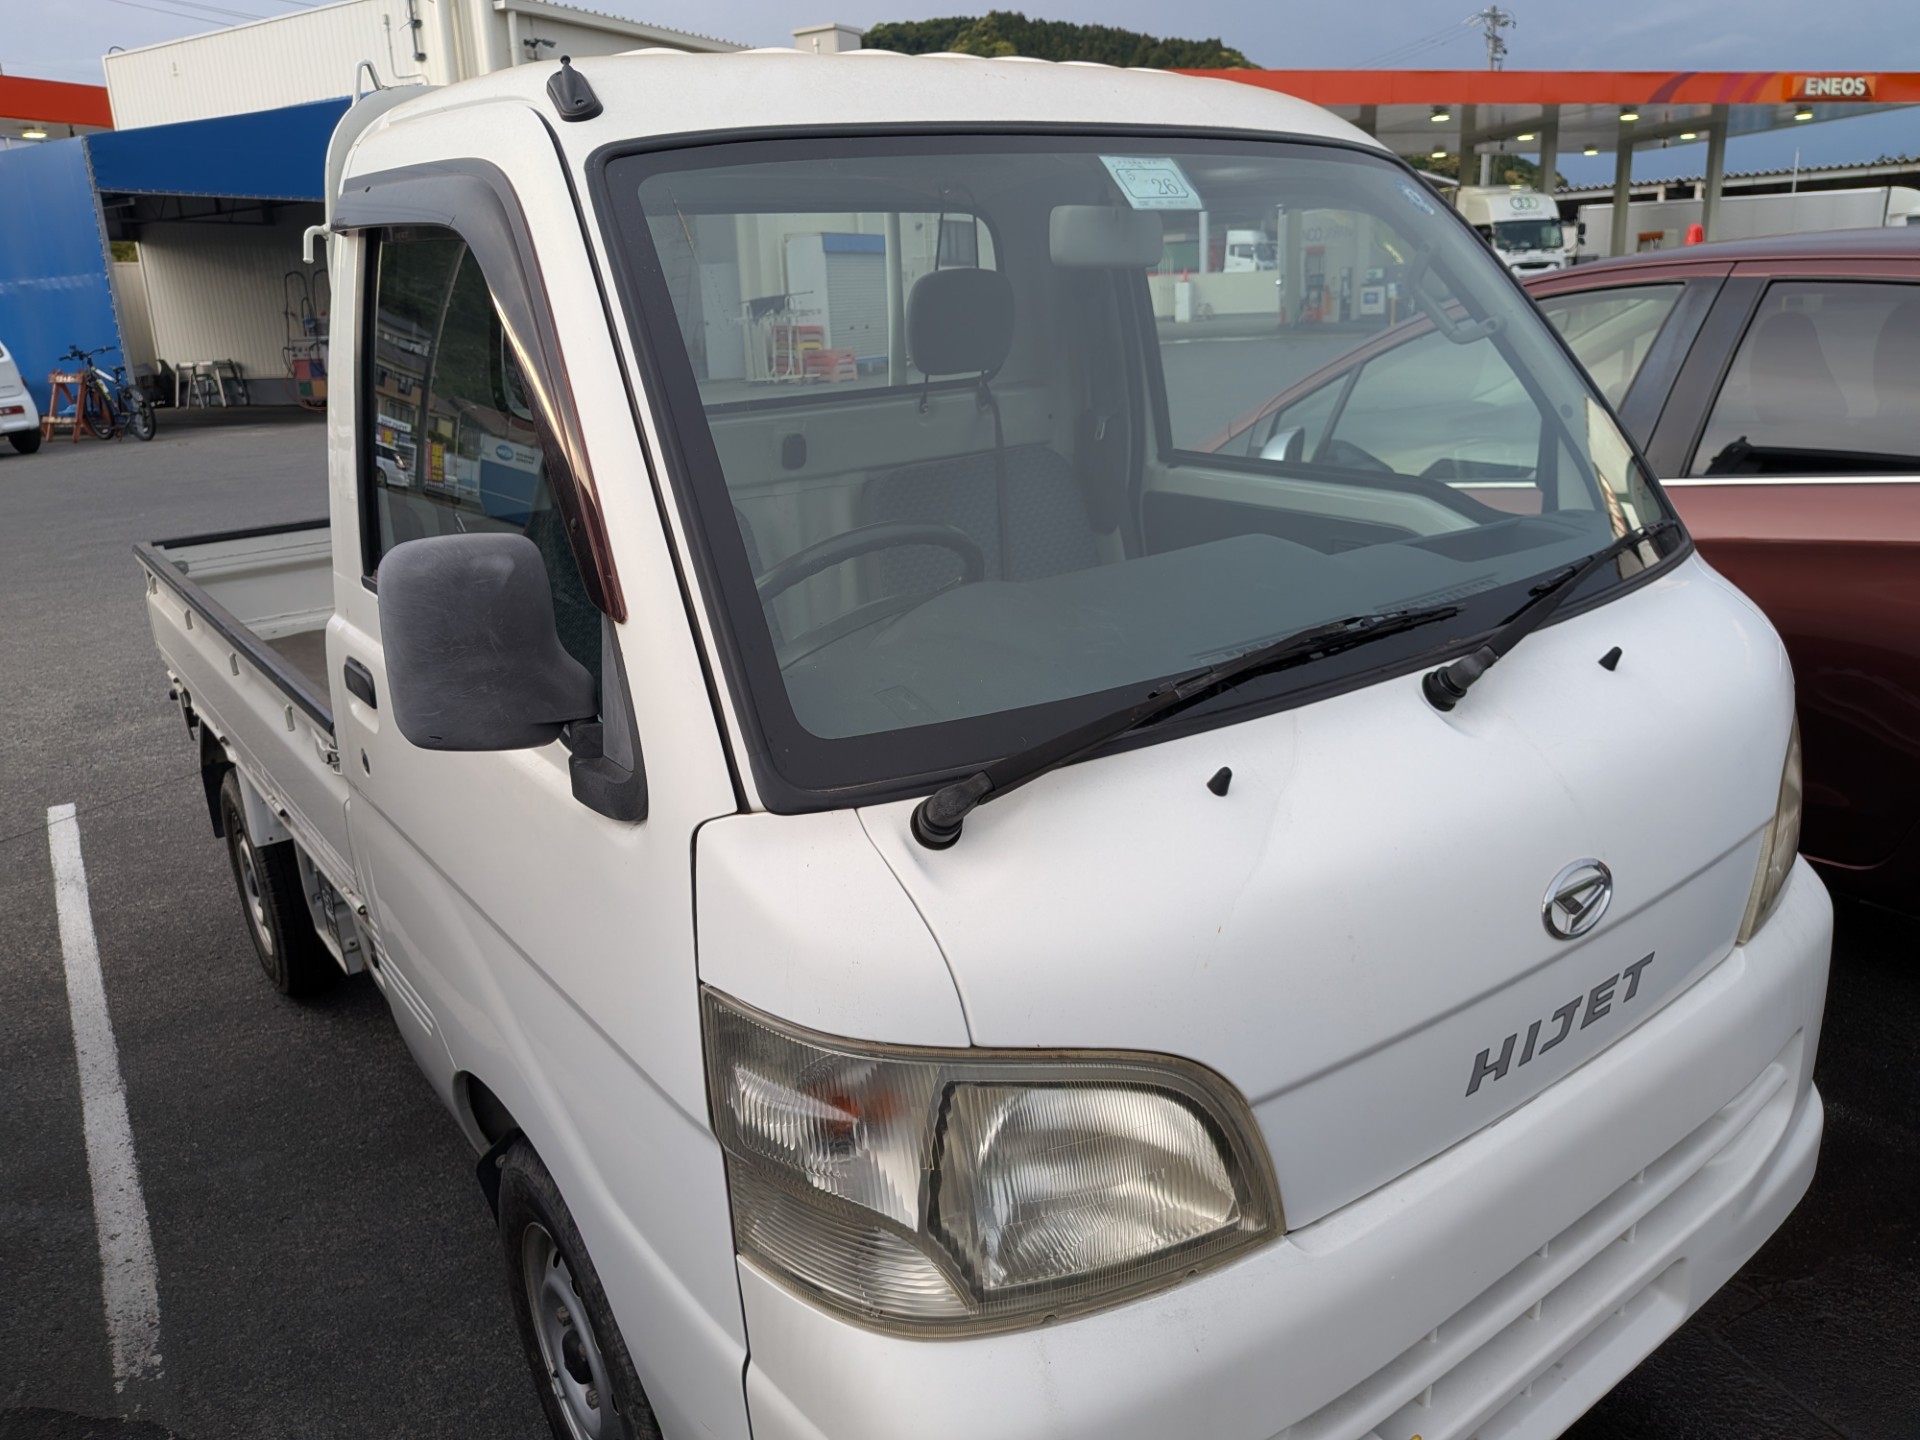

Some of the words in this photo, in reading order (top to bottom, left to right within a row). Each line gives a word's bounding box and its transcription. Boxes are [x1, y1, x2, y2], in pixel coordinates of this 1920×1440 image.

[1805, 77, 1866, 96] ENEOS
[1151, 178, 1179, 195] 26
[1465, 951, 1656, 1097] HIJET
